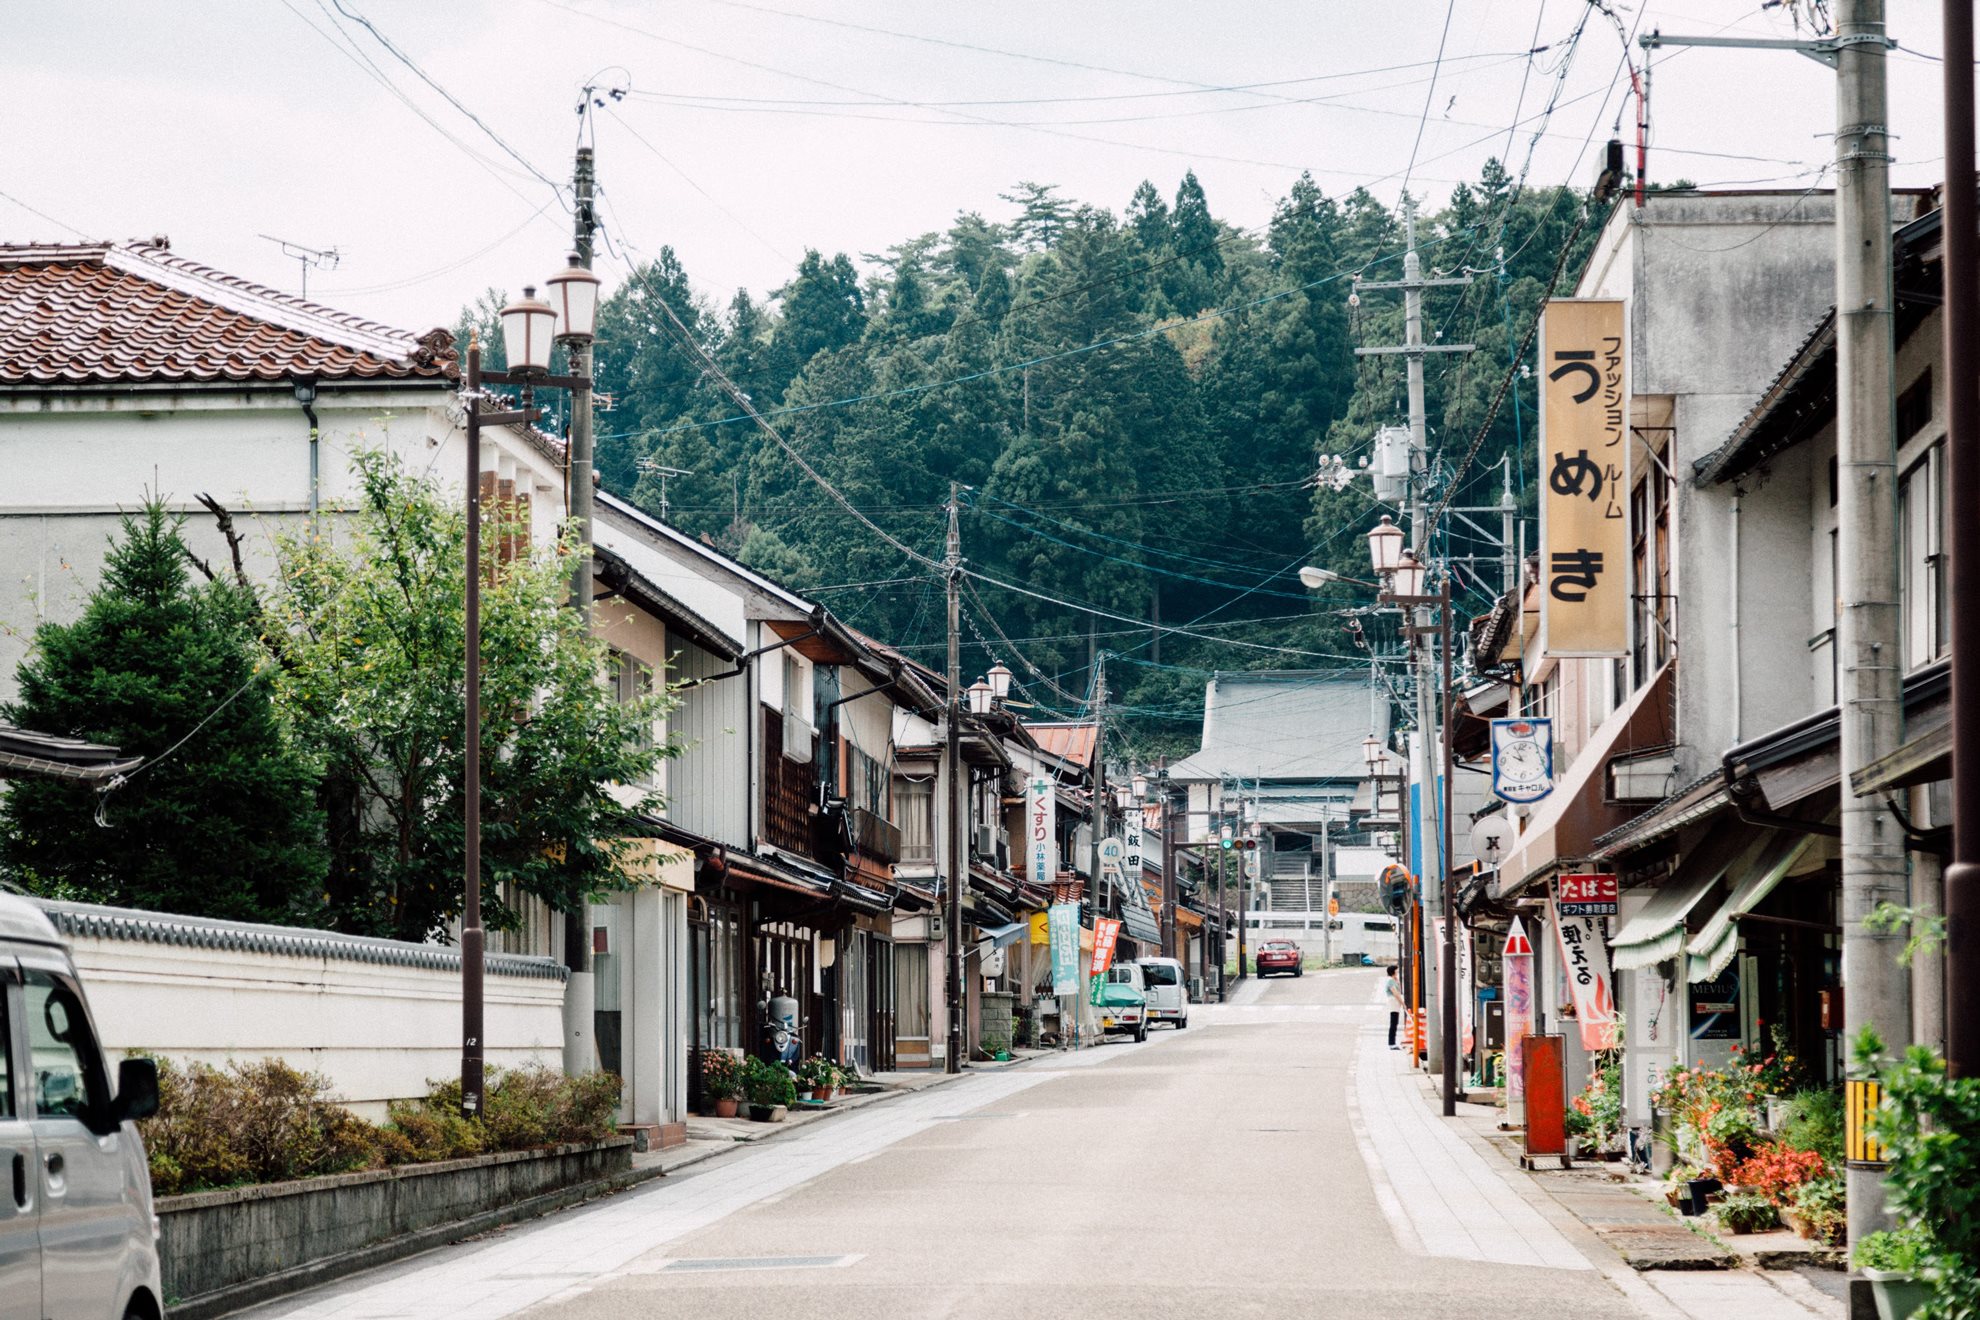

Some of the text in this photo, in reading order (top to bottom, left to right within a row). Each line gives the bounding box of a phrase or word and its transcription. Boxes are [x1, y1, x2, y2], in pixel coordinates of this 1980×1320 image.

[1549, 350, 1602, 602] うめき
[1603, 463, 1623, 519] ルーム
[1033, 797, 1048, 841] くすり
[1036, 843, 1046, 881] 小林薬局
[1104, 845, 1119, 857] 40
[1128, 834, 1140, 866] 飯田
[1561, 880, 1617, 898] たばこ
[1692, 984, 1736, 994] MEVIUS
[466, 1037, 477, 1046] 12
